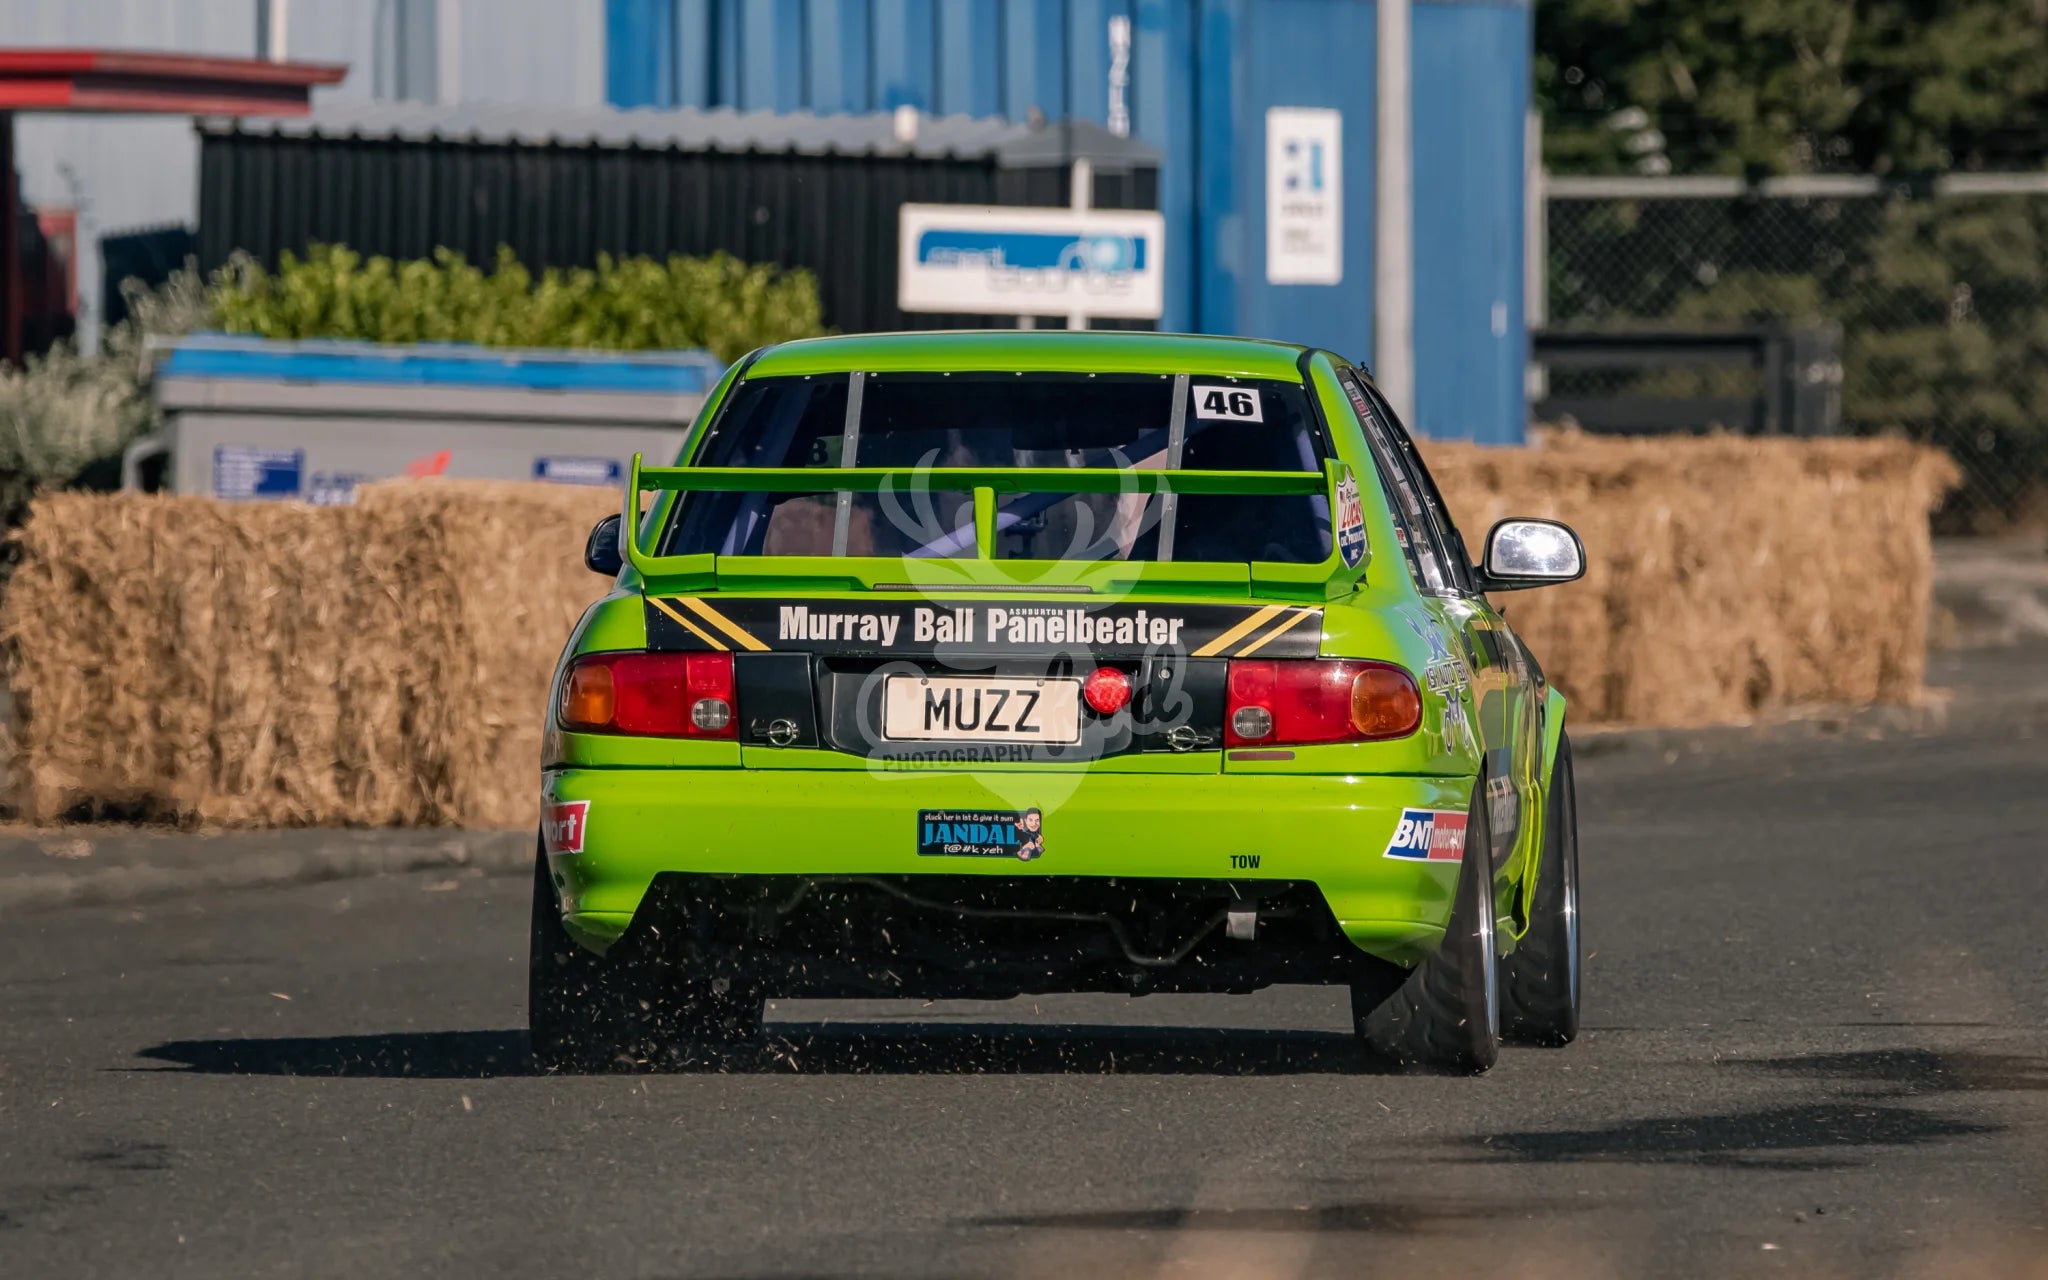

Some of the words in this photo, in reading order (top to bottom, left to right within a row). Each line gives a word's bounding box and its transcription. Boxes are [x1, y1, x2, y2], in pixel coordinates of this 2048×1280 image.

[1203, 391, 1254, 416] 46
[1009, 608, 1063, 616] ASHBURTON
[779, 606, 900, 647] Murray
[914, 608, 974, 642] Ball
[987, 608, 1184, 645] Panelbeater
[924, 687, 1041, 732] MUZZ
[943, 813, 954, 821] her
[922, 823, 1020, 846] JANDAL
[1392, 819, 1433, 850] BNT
[982, 845, 1003, 854] yeh
[1230, 855, 1260, 869] TOW
